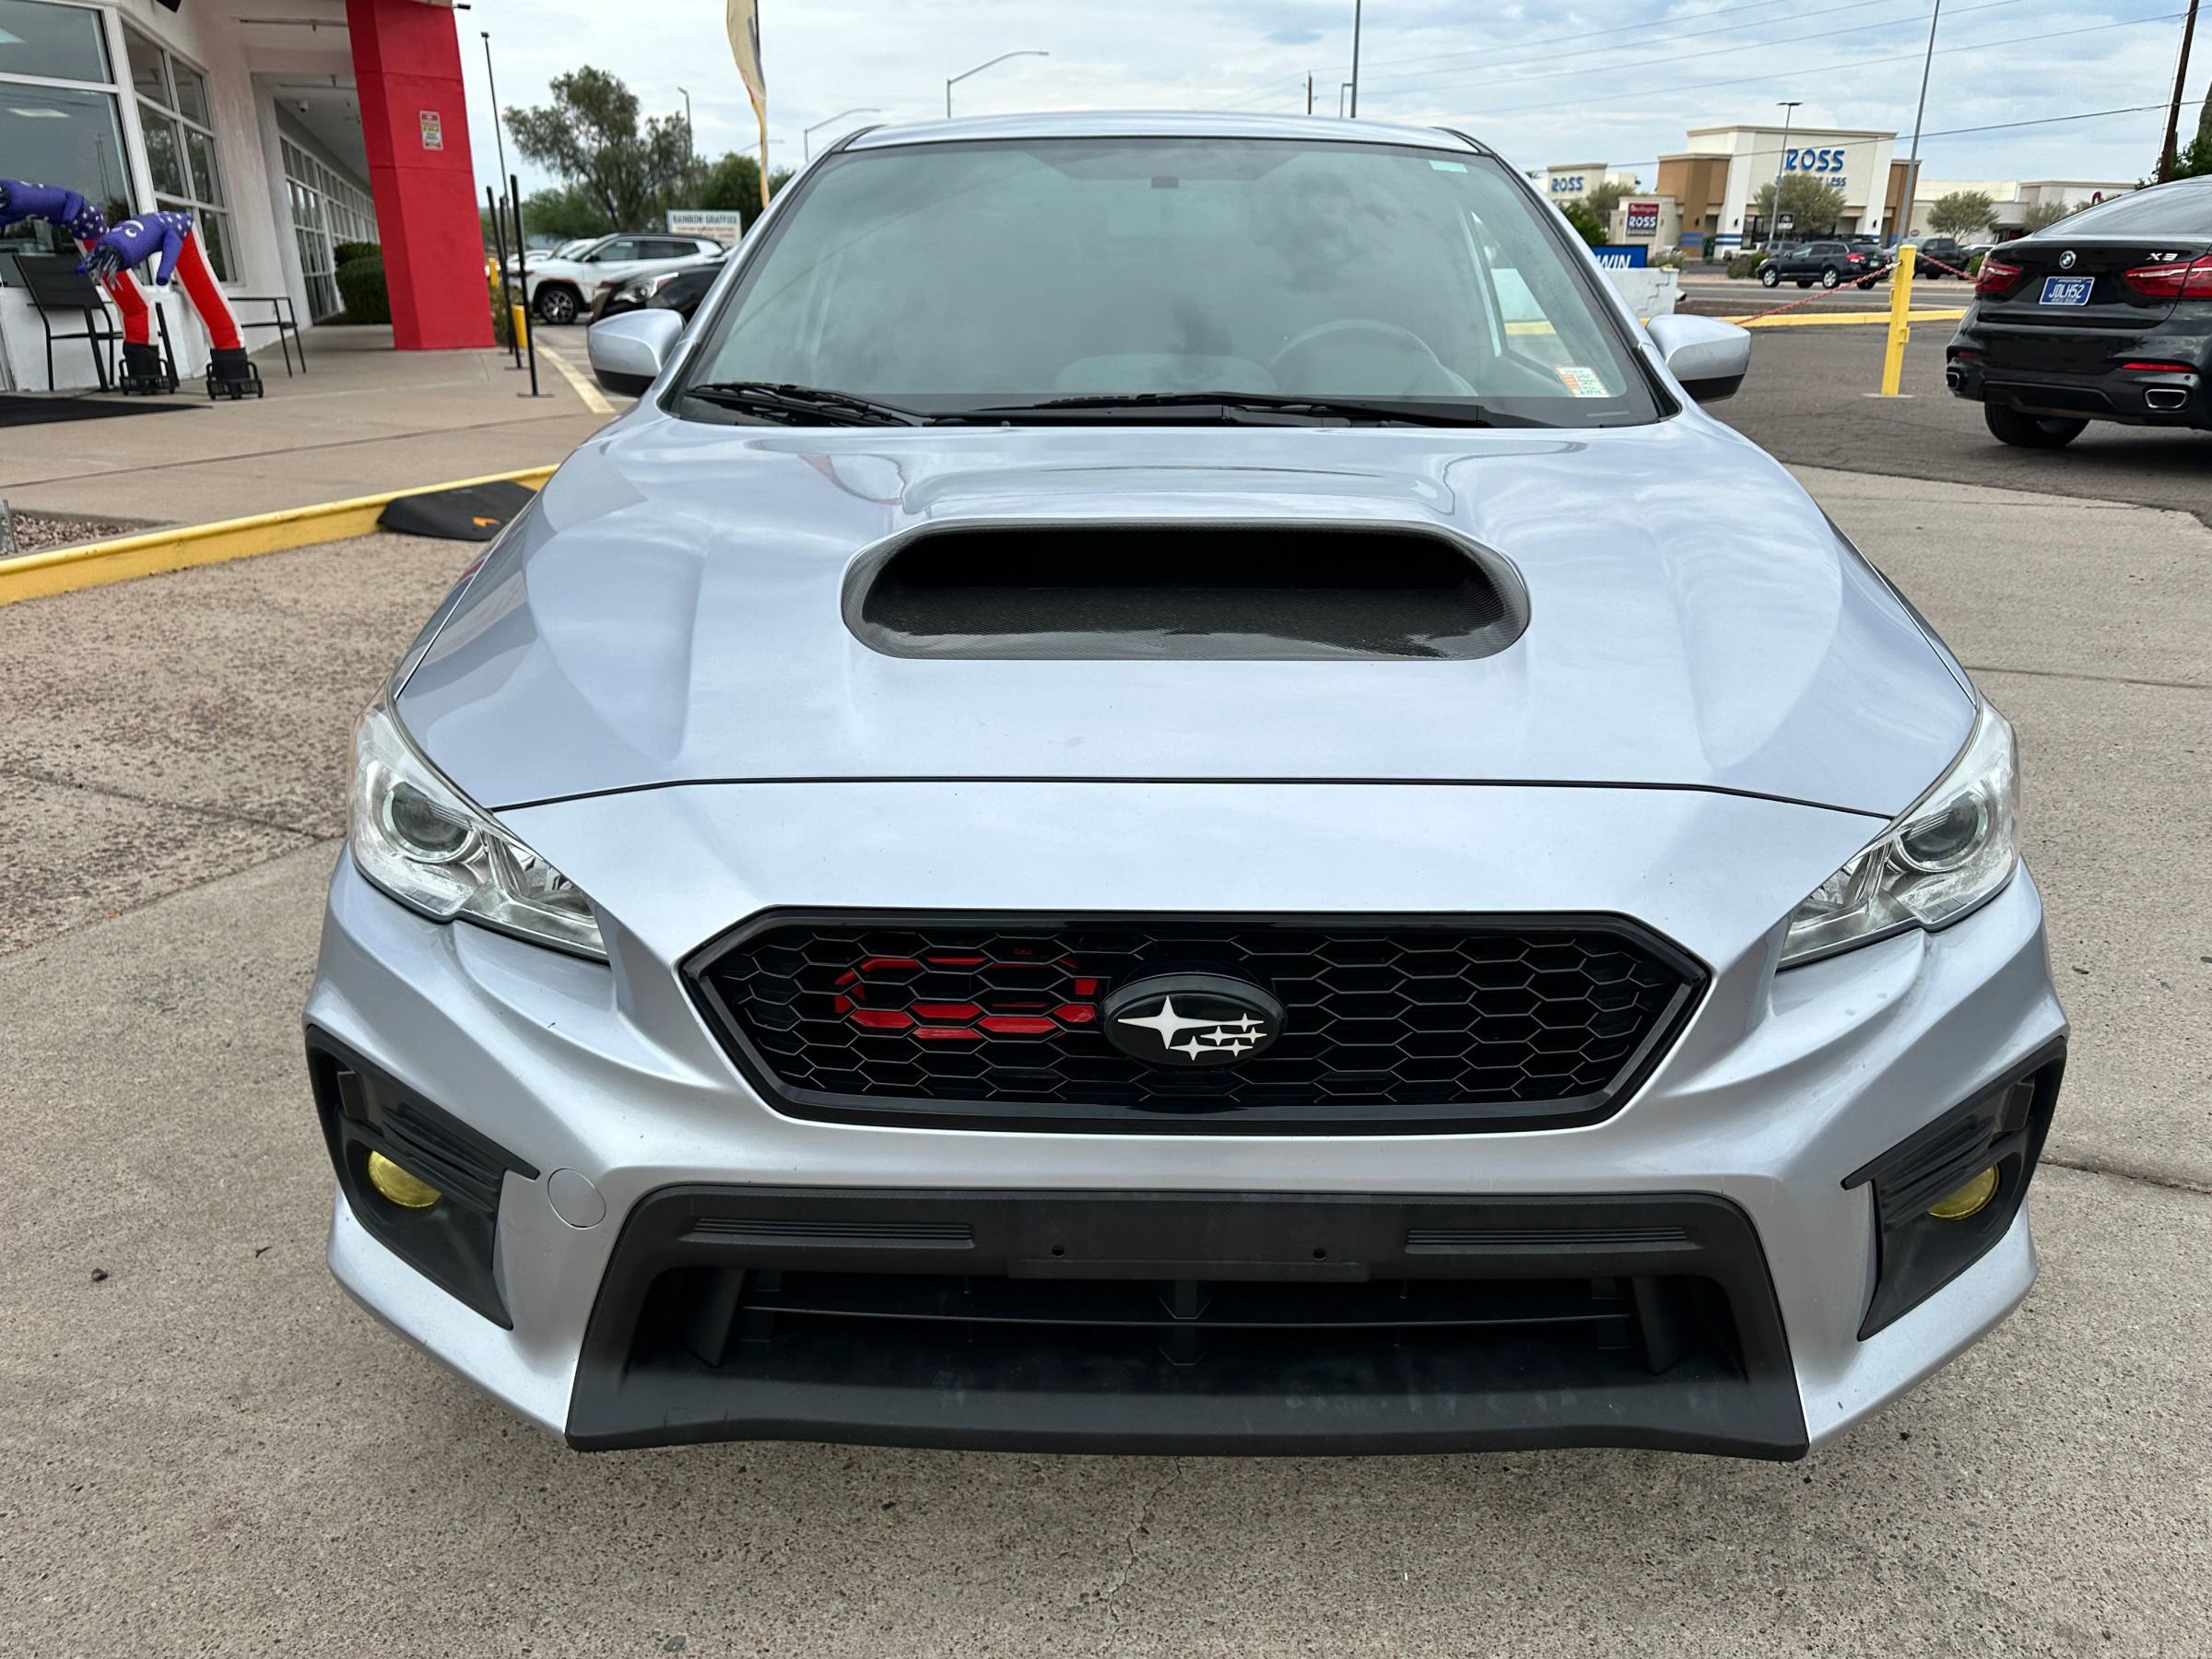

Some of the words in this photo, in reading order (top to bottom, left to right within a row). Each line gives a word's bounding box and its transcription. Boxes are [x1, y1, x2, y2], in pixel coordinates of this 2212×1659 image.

[1784, 147, 1845, 172] ROSS
[1550, 176, 1584, 192] ROSS
[1629, 216, 1657, 228] ROSS
